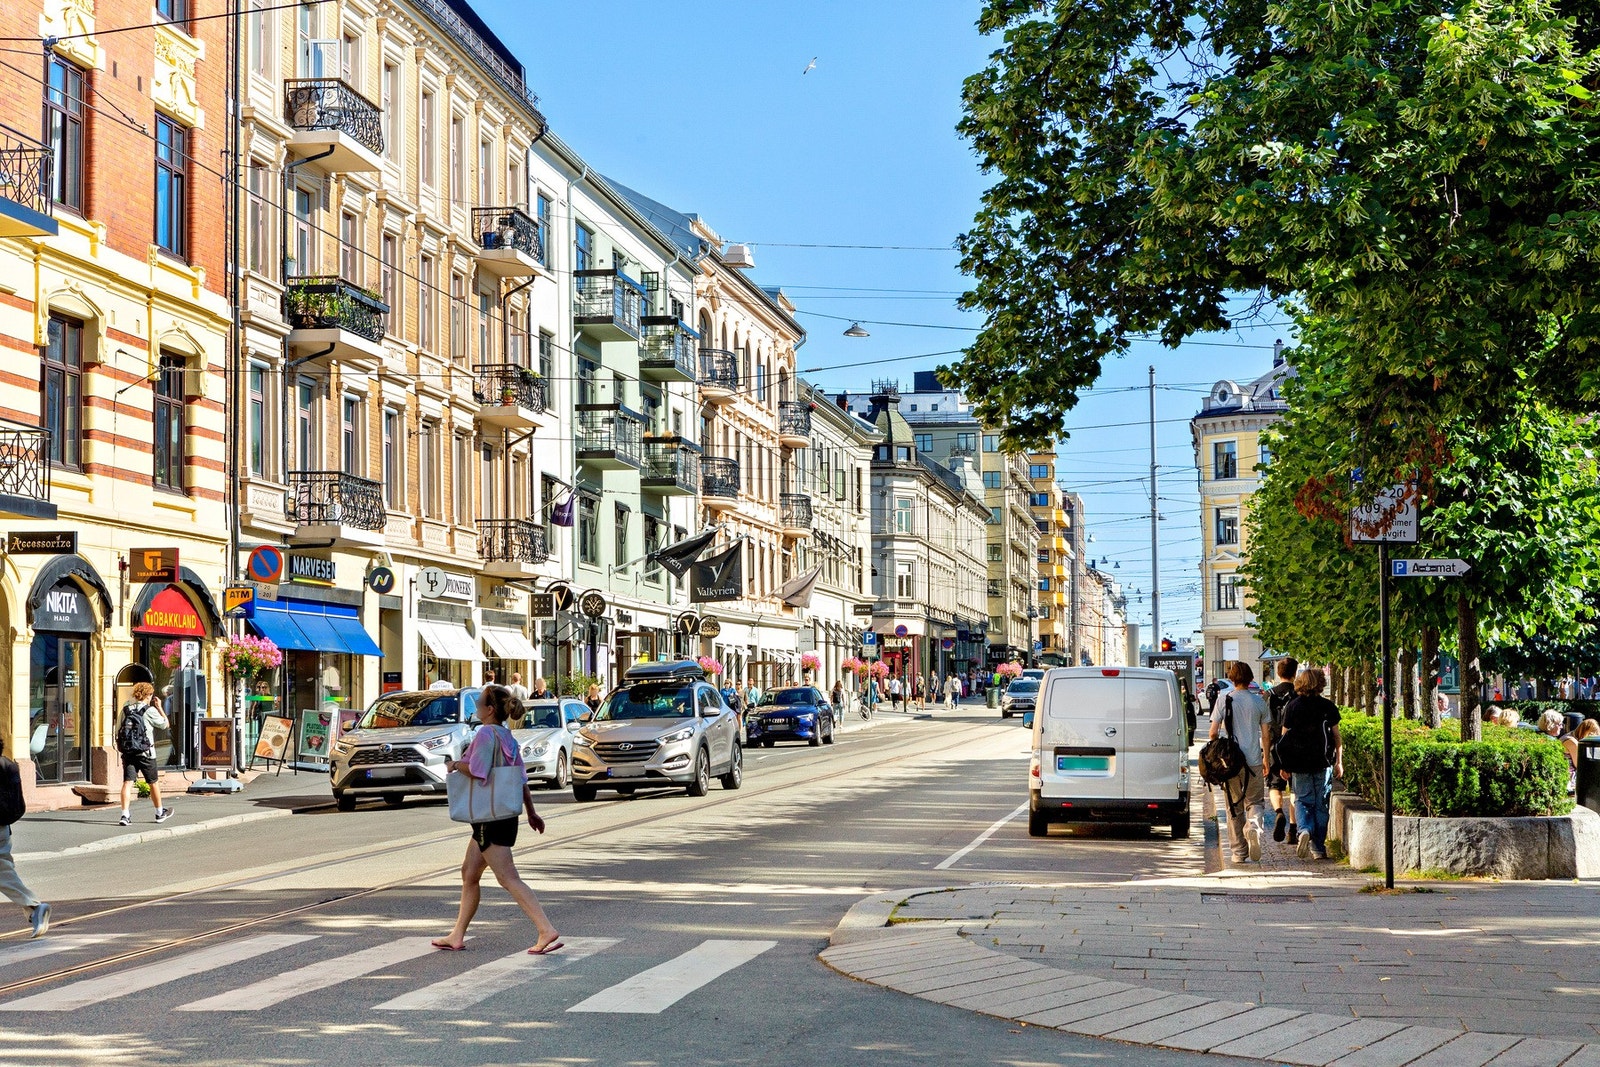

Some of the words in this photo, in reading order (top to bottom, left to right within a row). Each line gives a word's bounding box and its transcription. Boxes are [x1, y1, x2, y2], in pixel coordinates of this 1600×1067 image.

[10, 534, 71, 551] Accessorize
[293, 555, 336, 579] NARVESEN
[710, 562, 724, 583] V
[1396, 562, 1404, 574] P
[229, 590, 250, 599] ATM
[696, 586, 736, 598] Valkyrien
[46, 591, 78, 614] NIKITA
[866, 633, 873, 644] P
